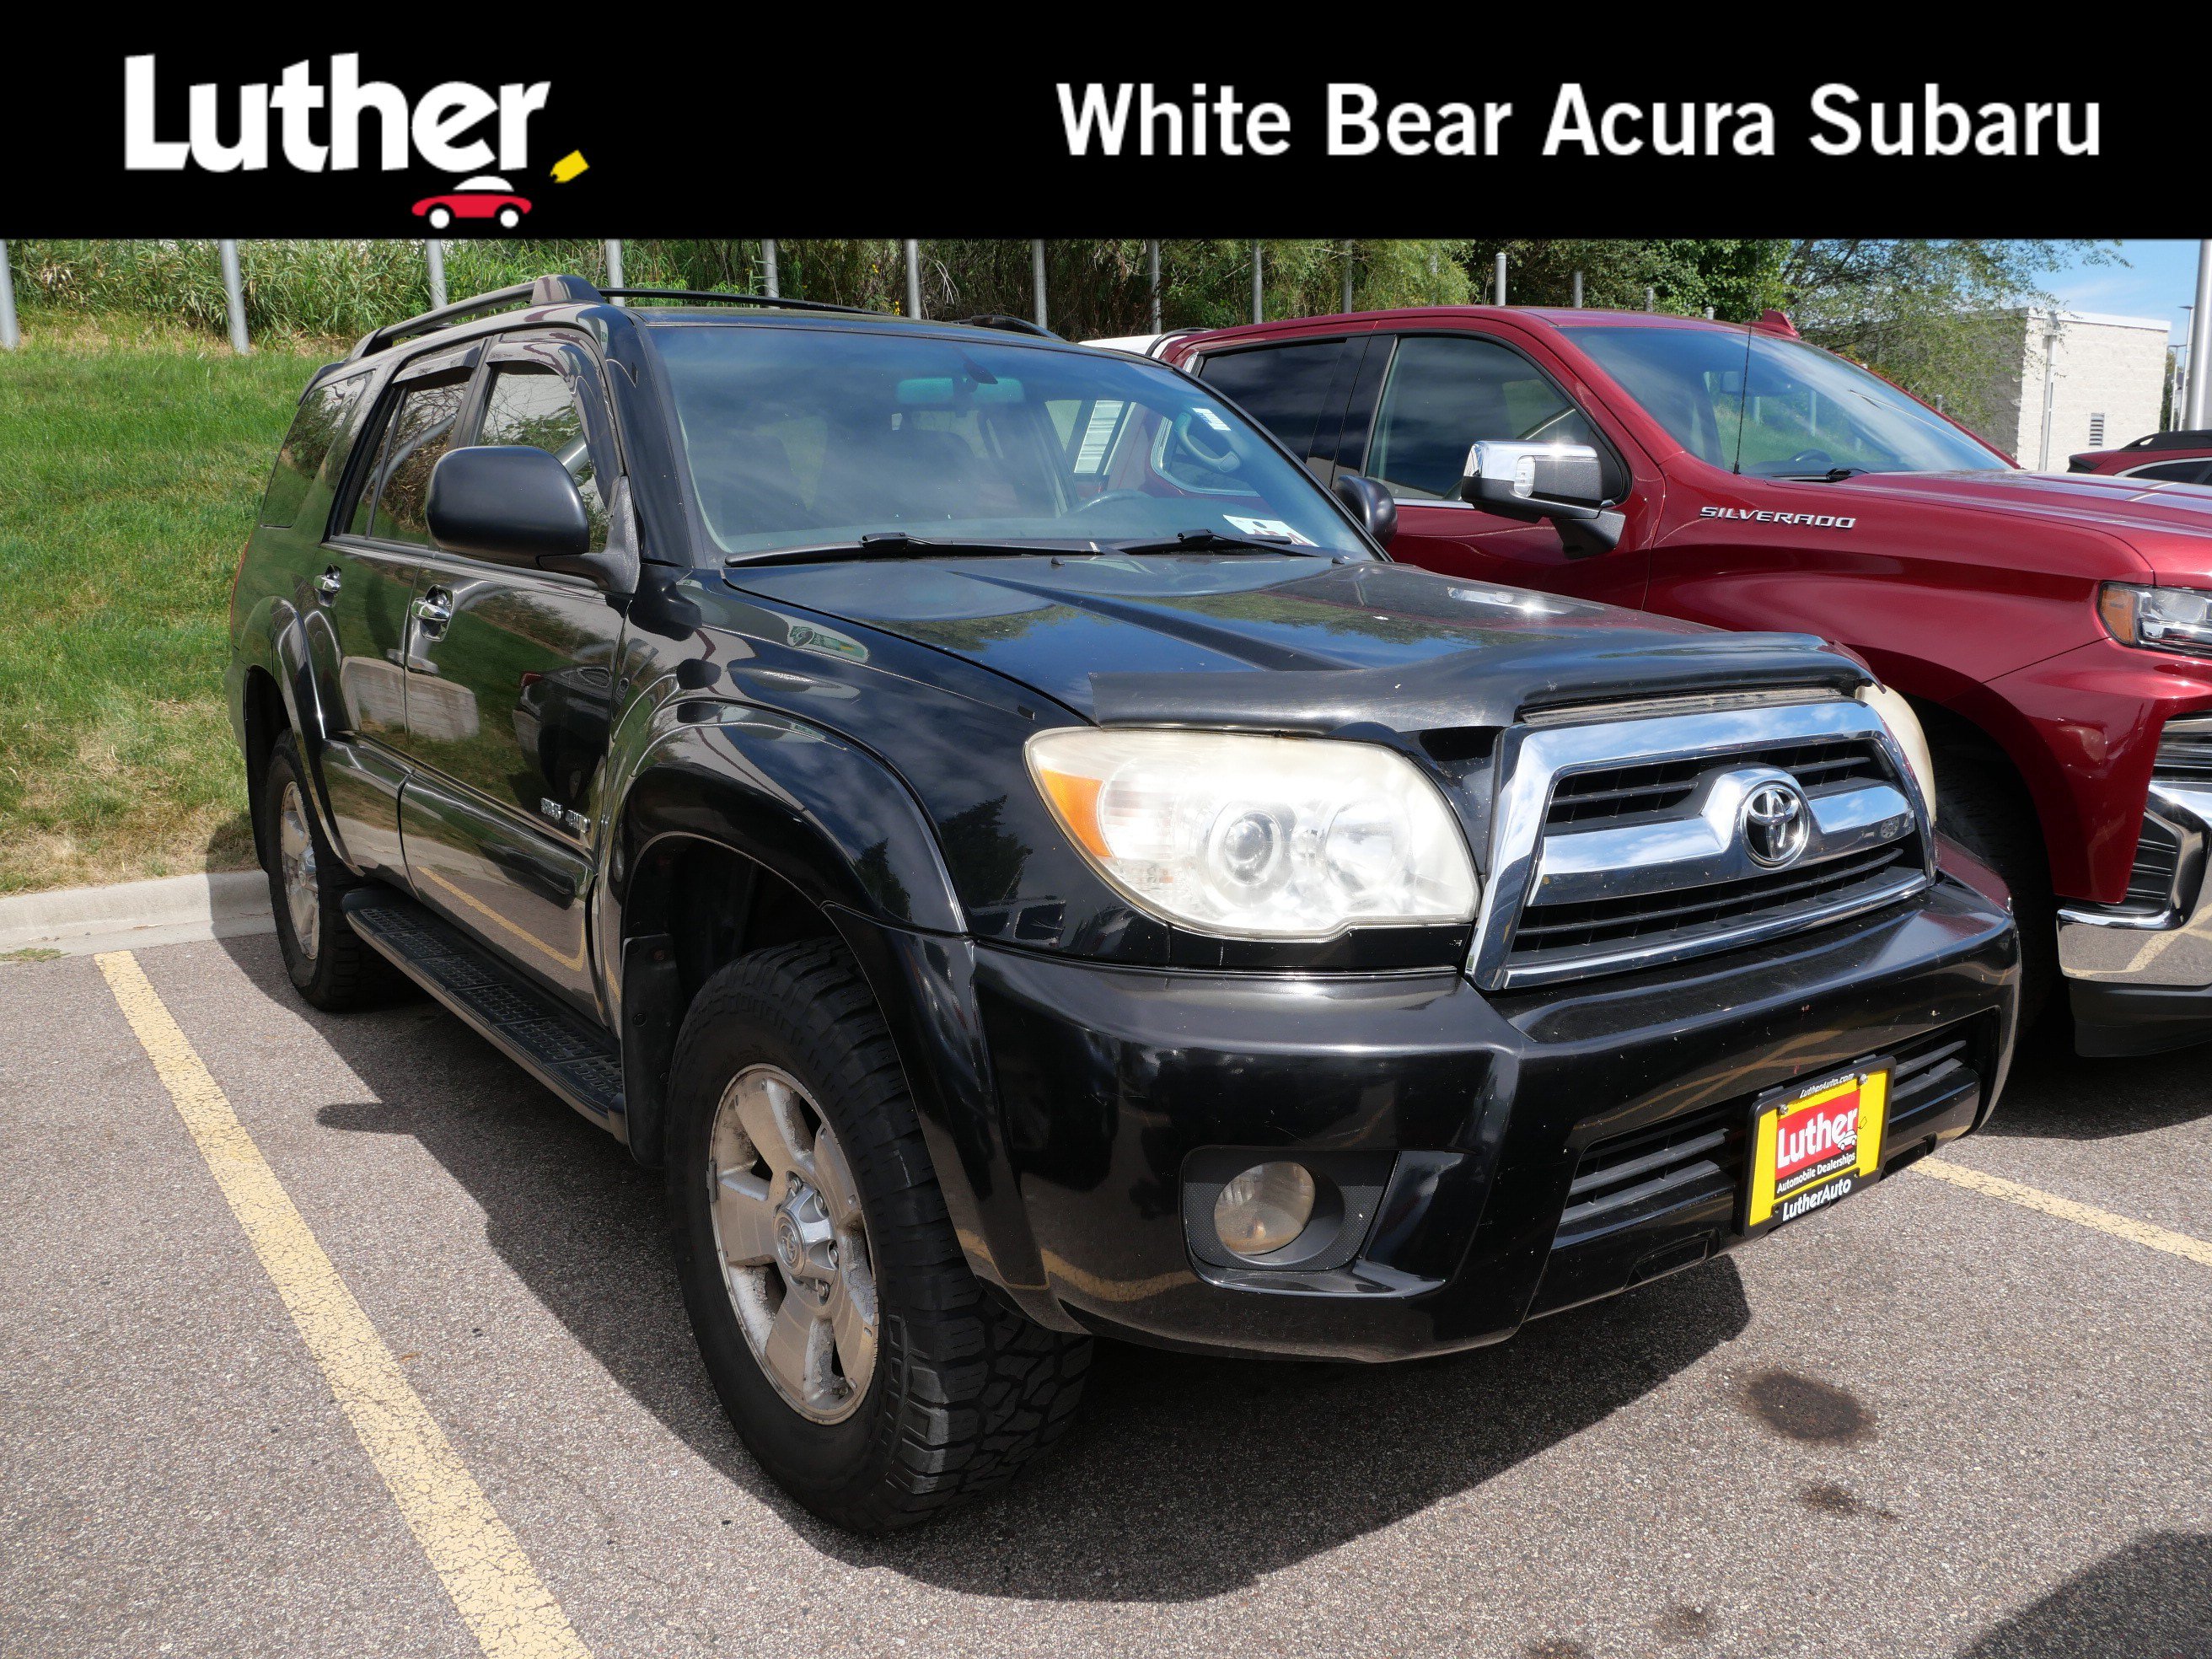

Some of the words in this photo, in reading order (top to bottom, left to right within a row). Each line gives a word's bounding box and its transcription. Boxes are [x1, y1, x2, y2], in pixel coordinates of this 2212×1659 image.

[1699, 507, 1856, 529] SILVERADO
[1799, 1073, 1855, 1098] LutherAuto.com
[1777, 1108, 1858, 1168] Luther
[1776, 1169, 1816, 1195] Automobile
[1817, 1152, 1856, 1175] Dealerships
[1782, 1178, 1852, 1221] LutherAuto
